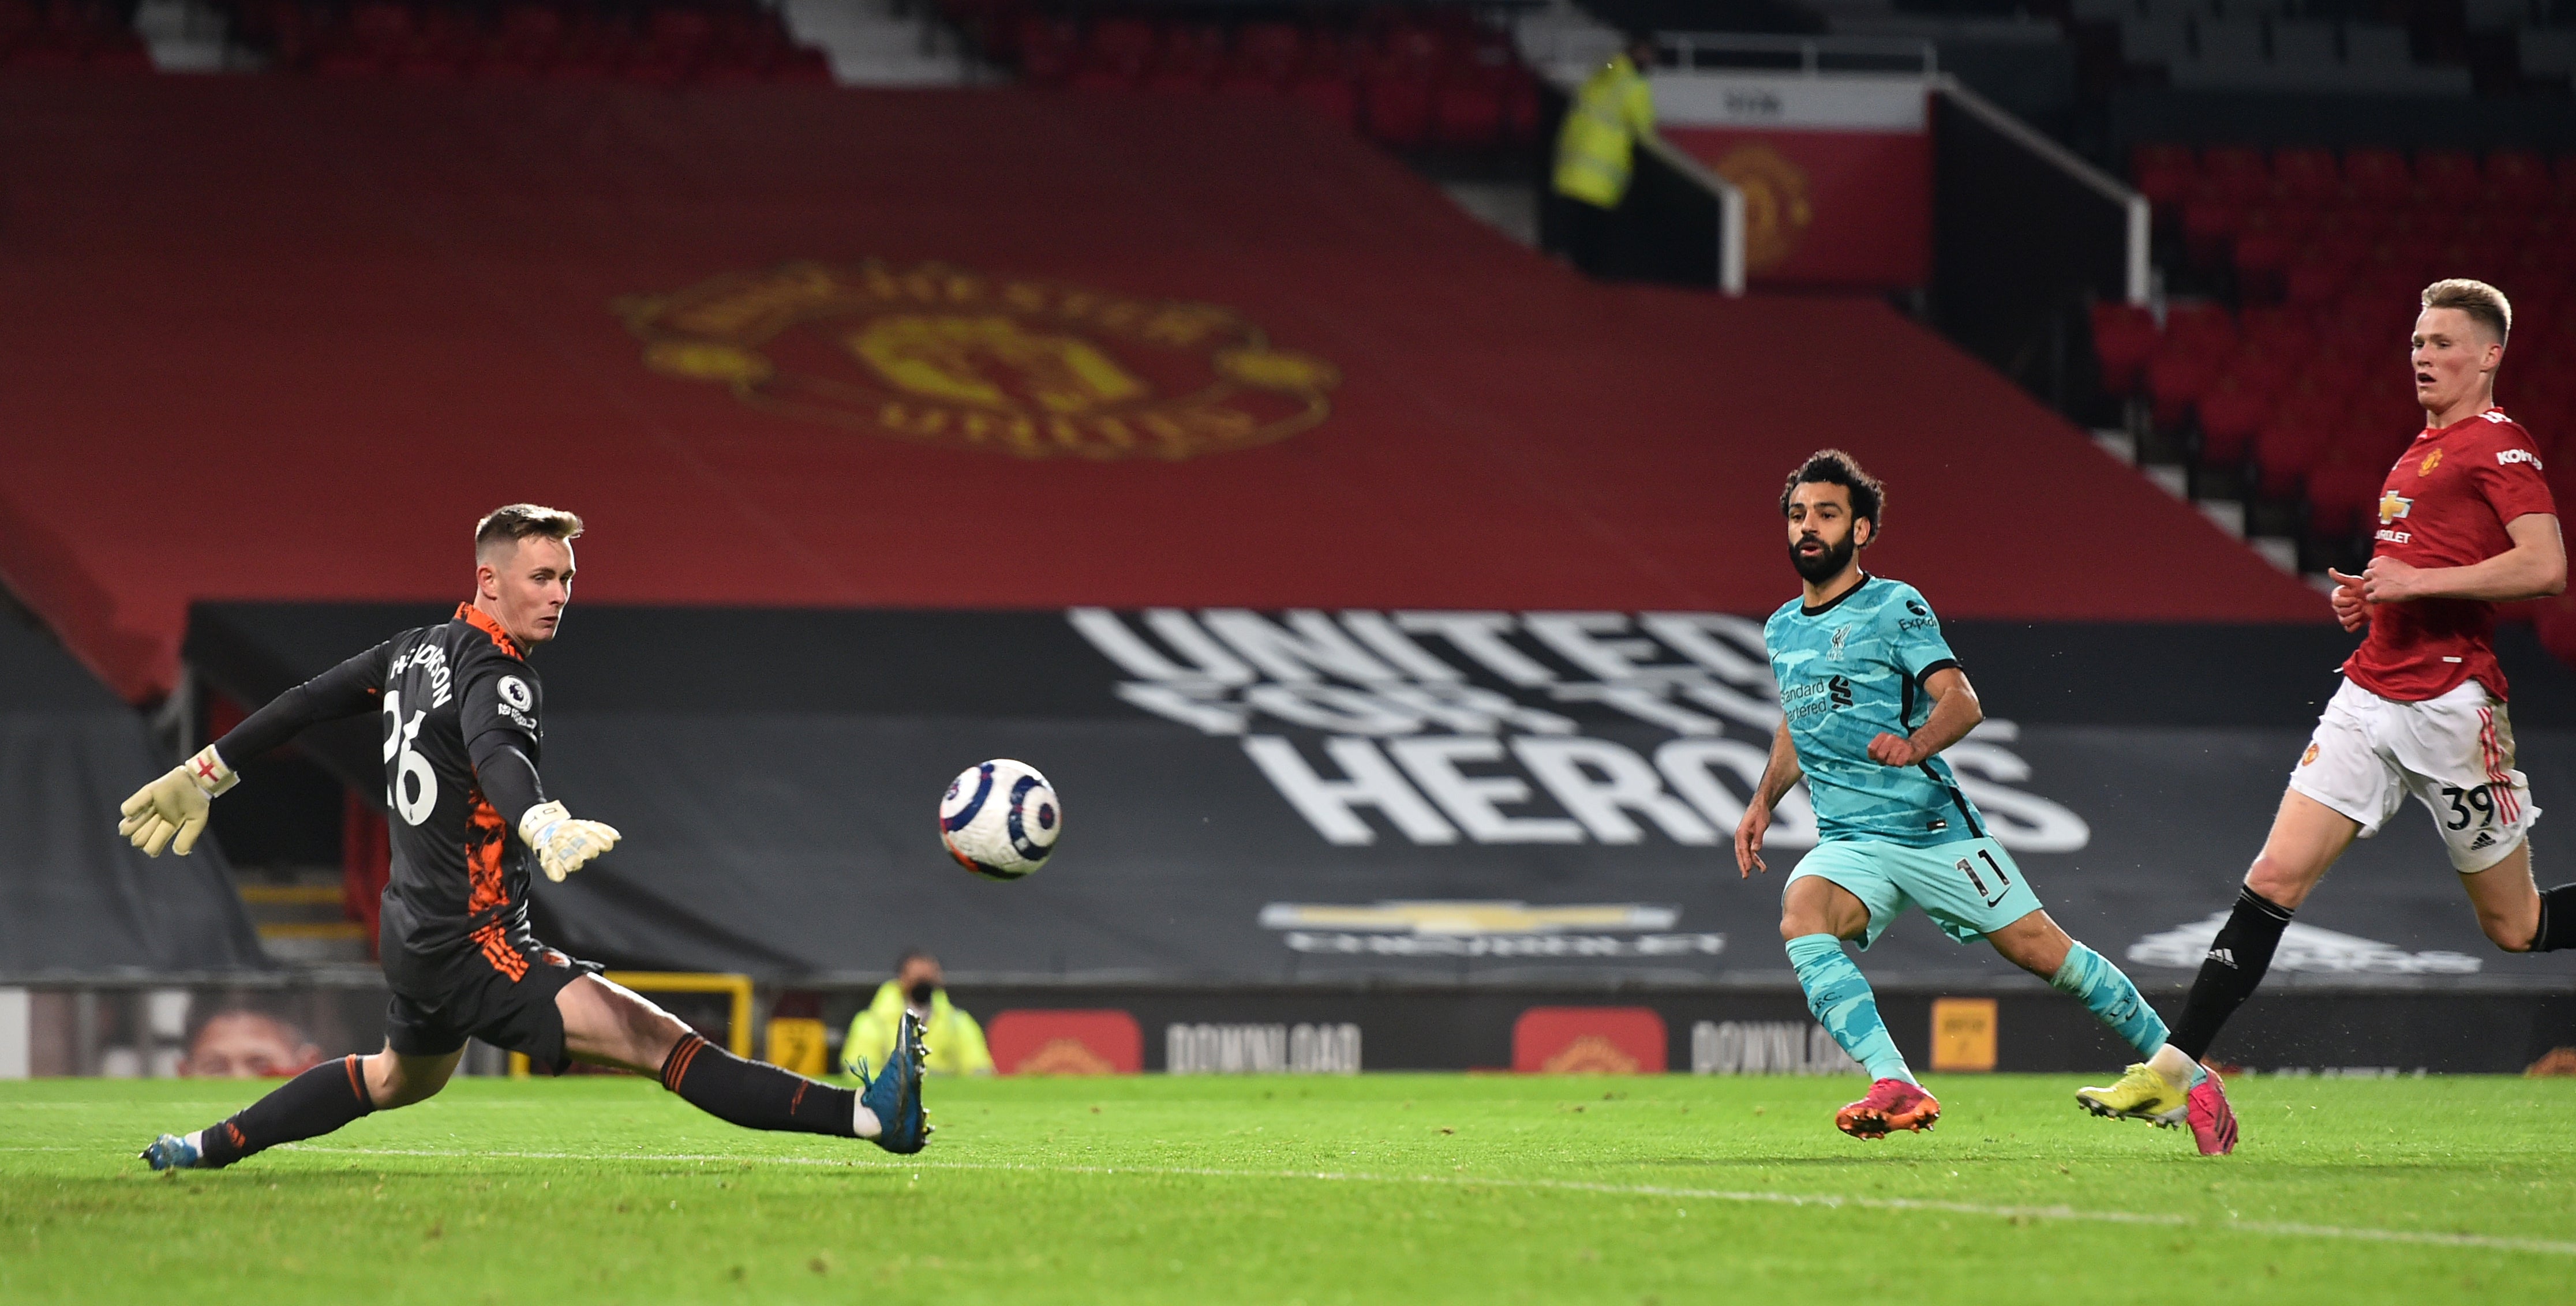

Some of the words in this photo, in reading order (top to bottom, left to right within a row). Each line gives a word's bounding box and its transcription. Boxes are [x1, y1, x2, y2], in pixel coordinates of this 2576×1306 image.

[1066, 606, 1780, 686] UNITED
[1780, 678, 1824, 705] Sandard
[1787, 697, 1826, 722] artered
[383, 690, 437, 826] 26
[1241, 734, 2090, 853] HEROS
[2442, 785, 2495, 831] 39
[1955, 848, 2011, 898] 11
[1166, 1022, 1362, 1073] DOWNLOAD
[1691, 1020, 1864, 1074] DOWNLO
